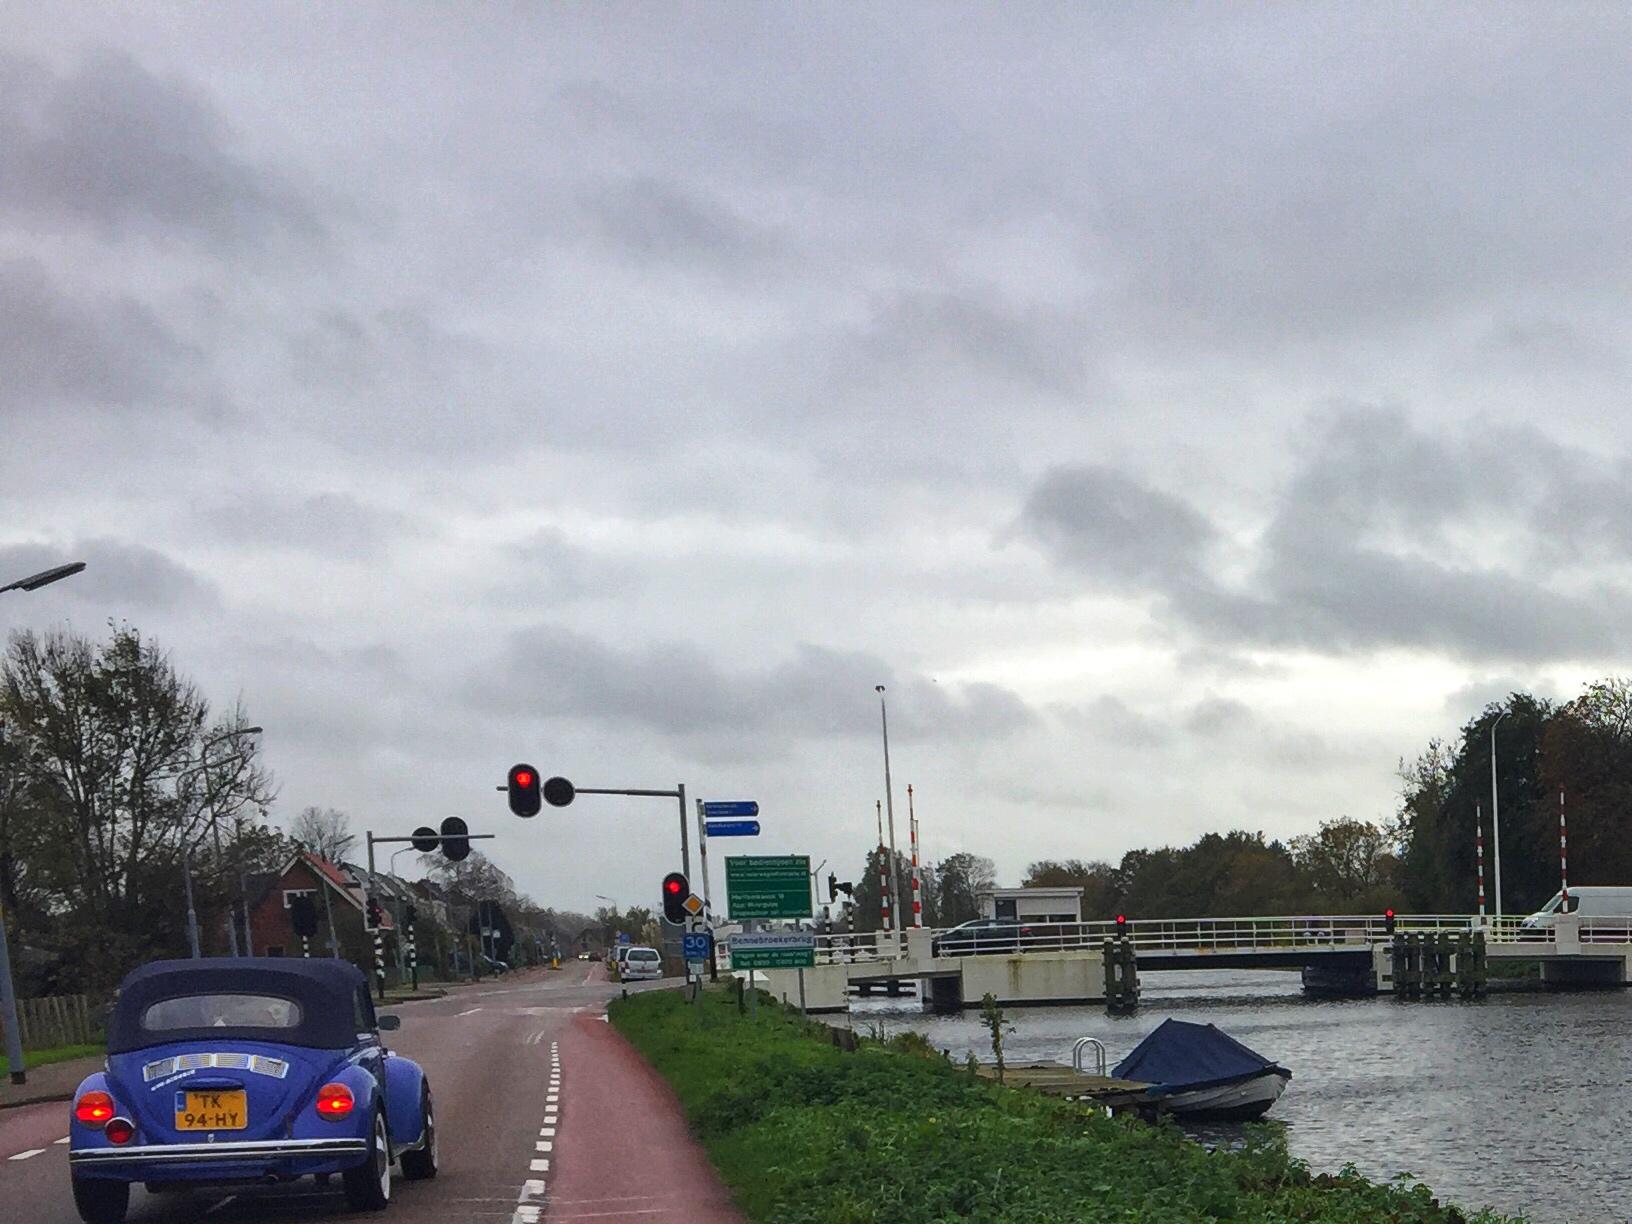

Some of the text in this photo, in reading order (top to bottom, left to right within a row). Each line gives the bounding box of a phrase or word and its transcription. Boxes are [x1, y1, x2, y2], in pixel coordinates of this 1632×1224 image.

[685, 936, 706, 949] 30
[200, 1094, 222, 1109] TK
[184, 1112, 239, 1128] 94-HY
